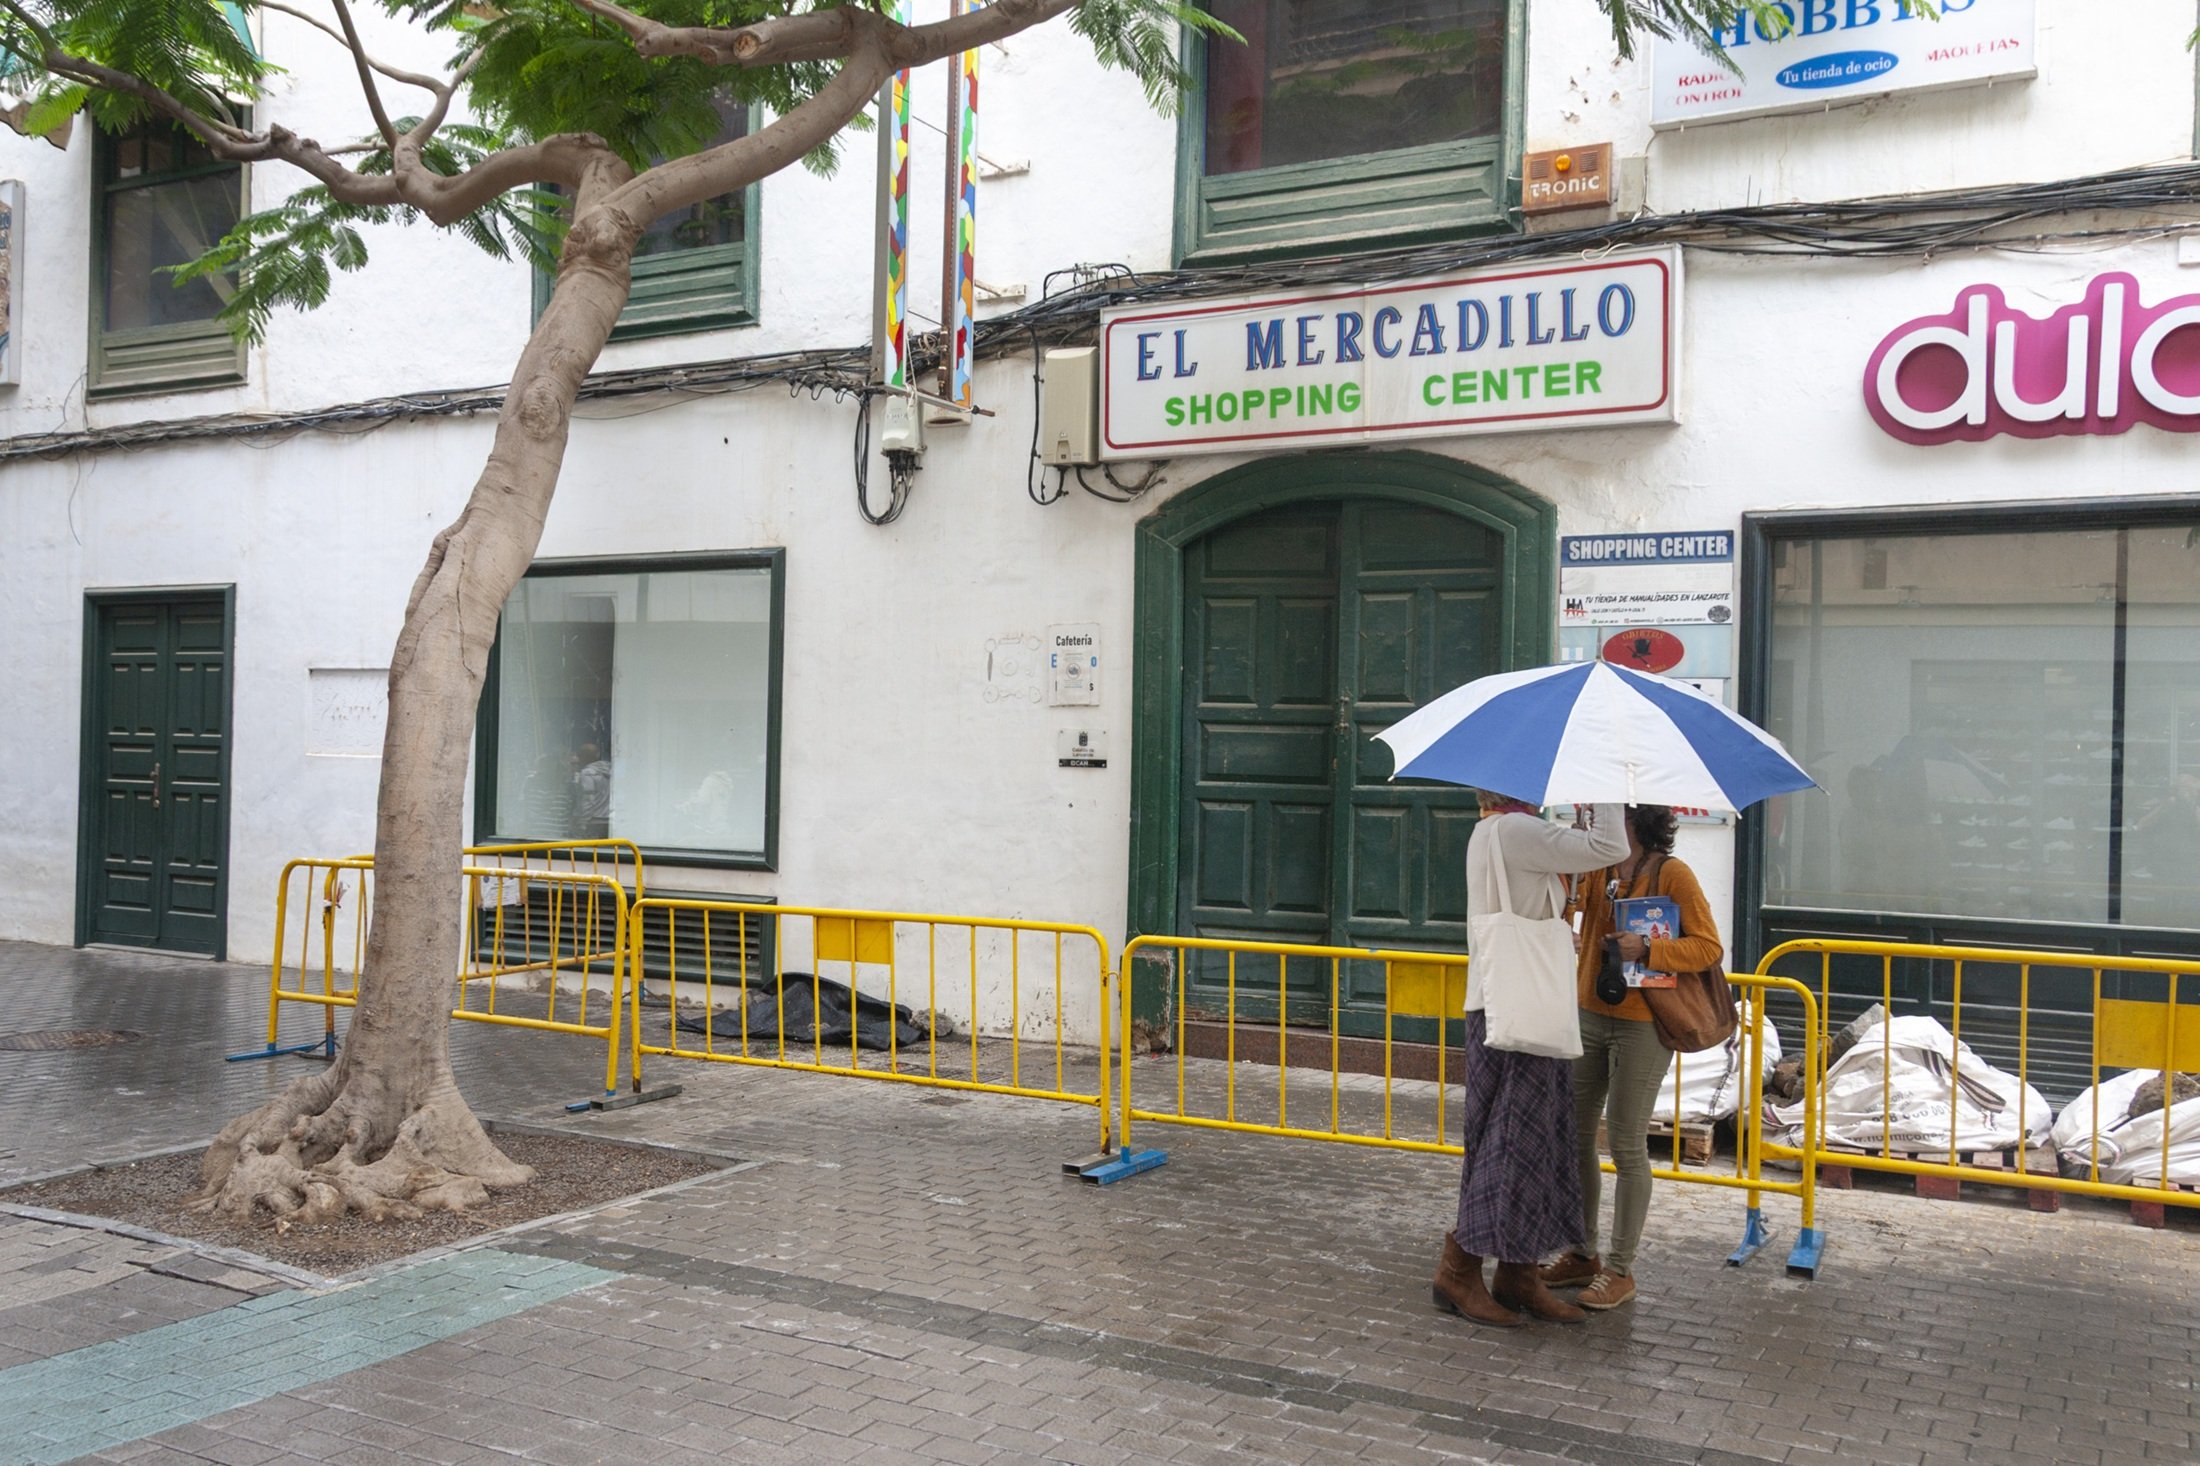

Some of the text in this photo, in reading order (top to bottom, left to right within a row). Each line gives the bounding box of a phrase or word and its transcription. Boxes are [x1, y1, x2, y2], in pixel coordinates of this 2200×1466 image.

[1708, 0, 1976, 49] HOBB
[1783, 57, 1892, 84] Tu tienda de ocio
[1137, 282, 1636, 381] EL MERCADILLO
[1164, 360, 1602, 427] SHOPPING CENTER
[1569, 535, 1728, 561] SHOPPING CENTER
[1619, 595, 1629, 603] DE
[1680, 593, 1690, 601] EN
[1056, 633, 1092, 646] Cafetería
